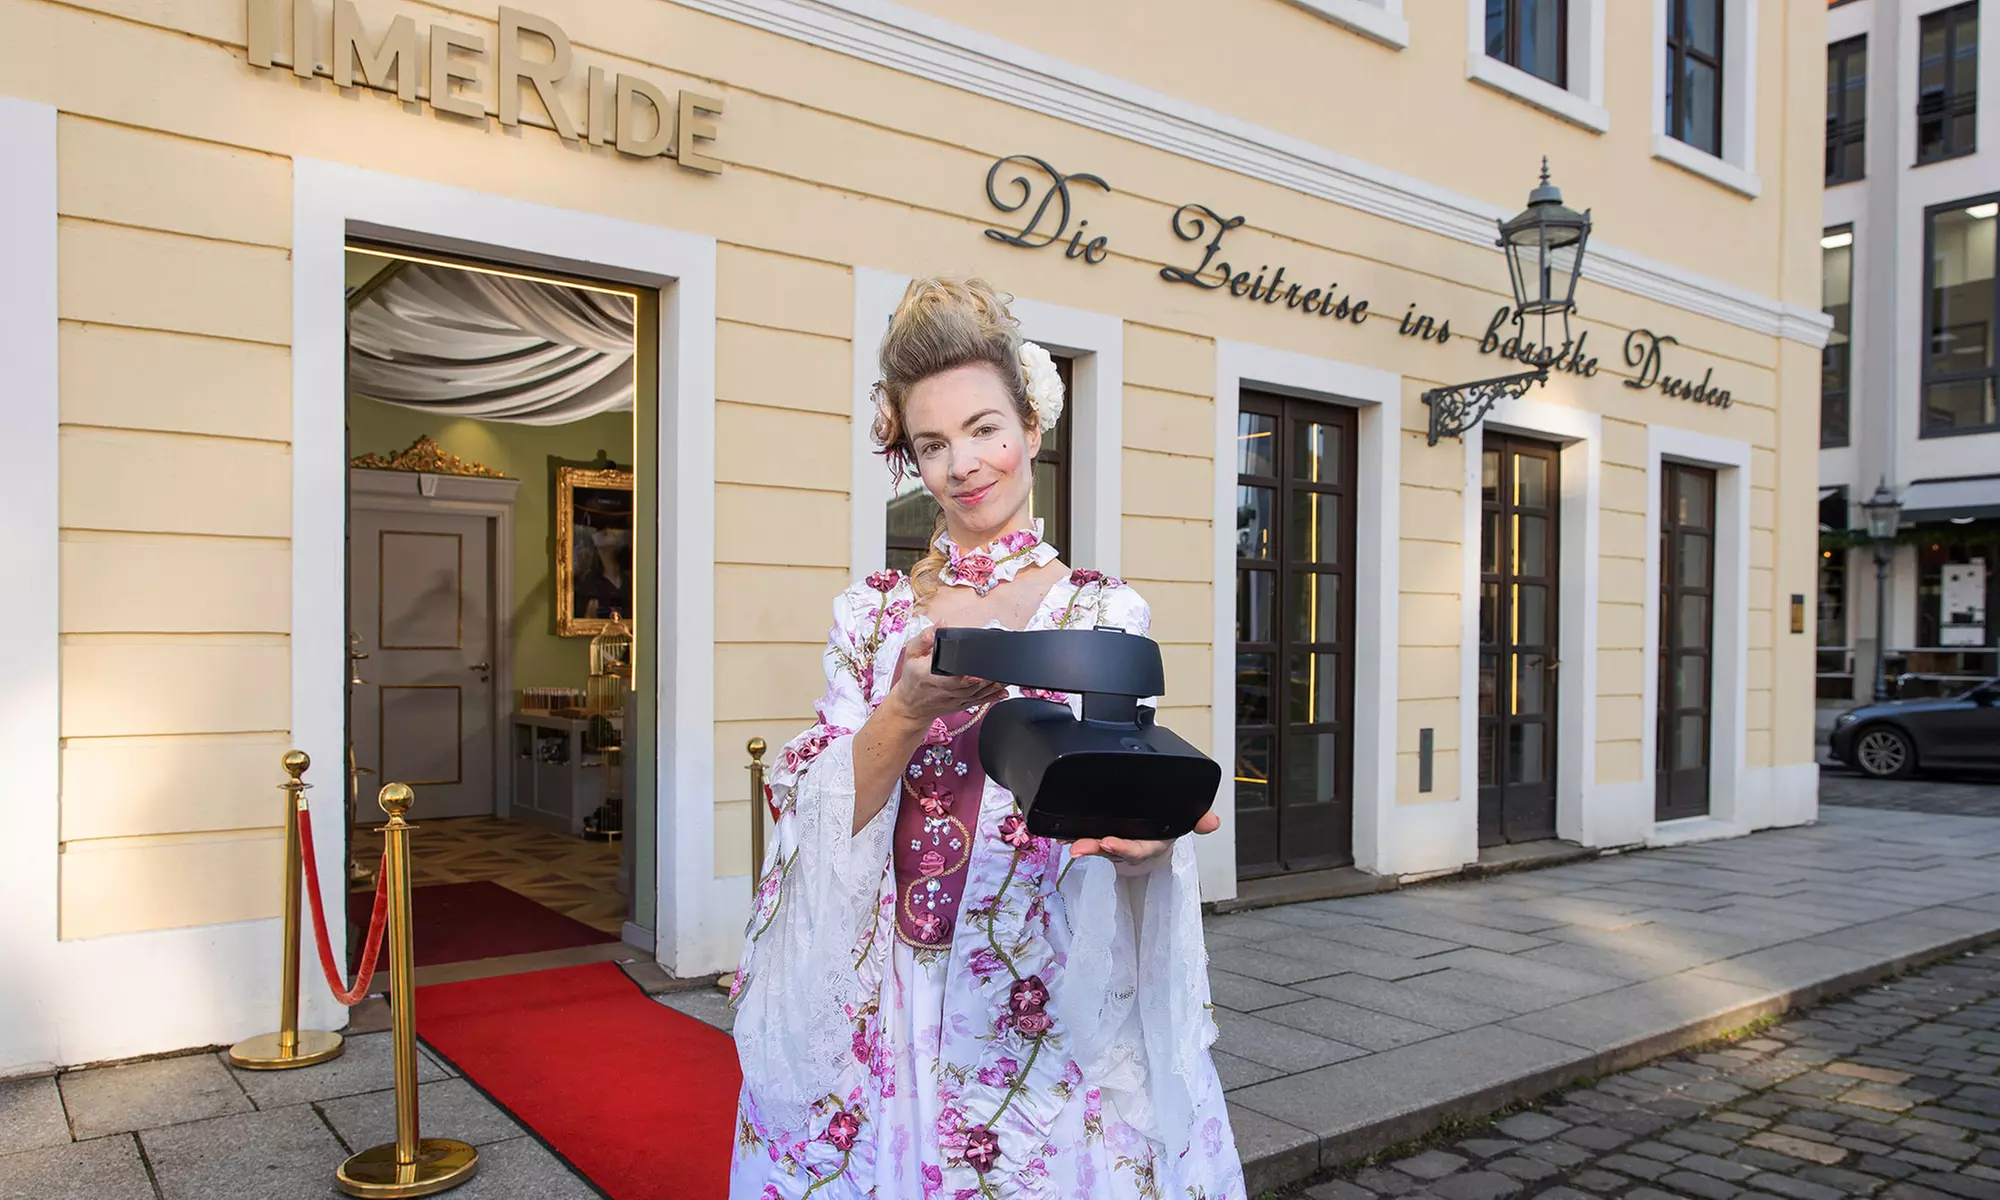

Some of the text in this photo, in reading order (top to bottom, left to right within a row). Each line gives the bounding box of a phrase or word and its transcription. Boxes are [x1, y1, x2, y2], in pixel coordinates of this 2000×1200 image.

[984, 154, 1111, 264] Die
[1160, 203, 1369, 324] Zeitreise
[1399, 302, 1451, 345] ins
[1623, 329, 1734, 409] Dresden
